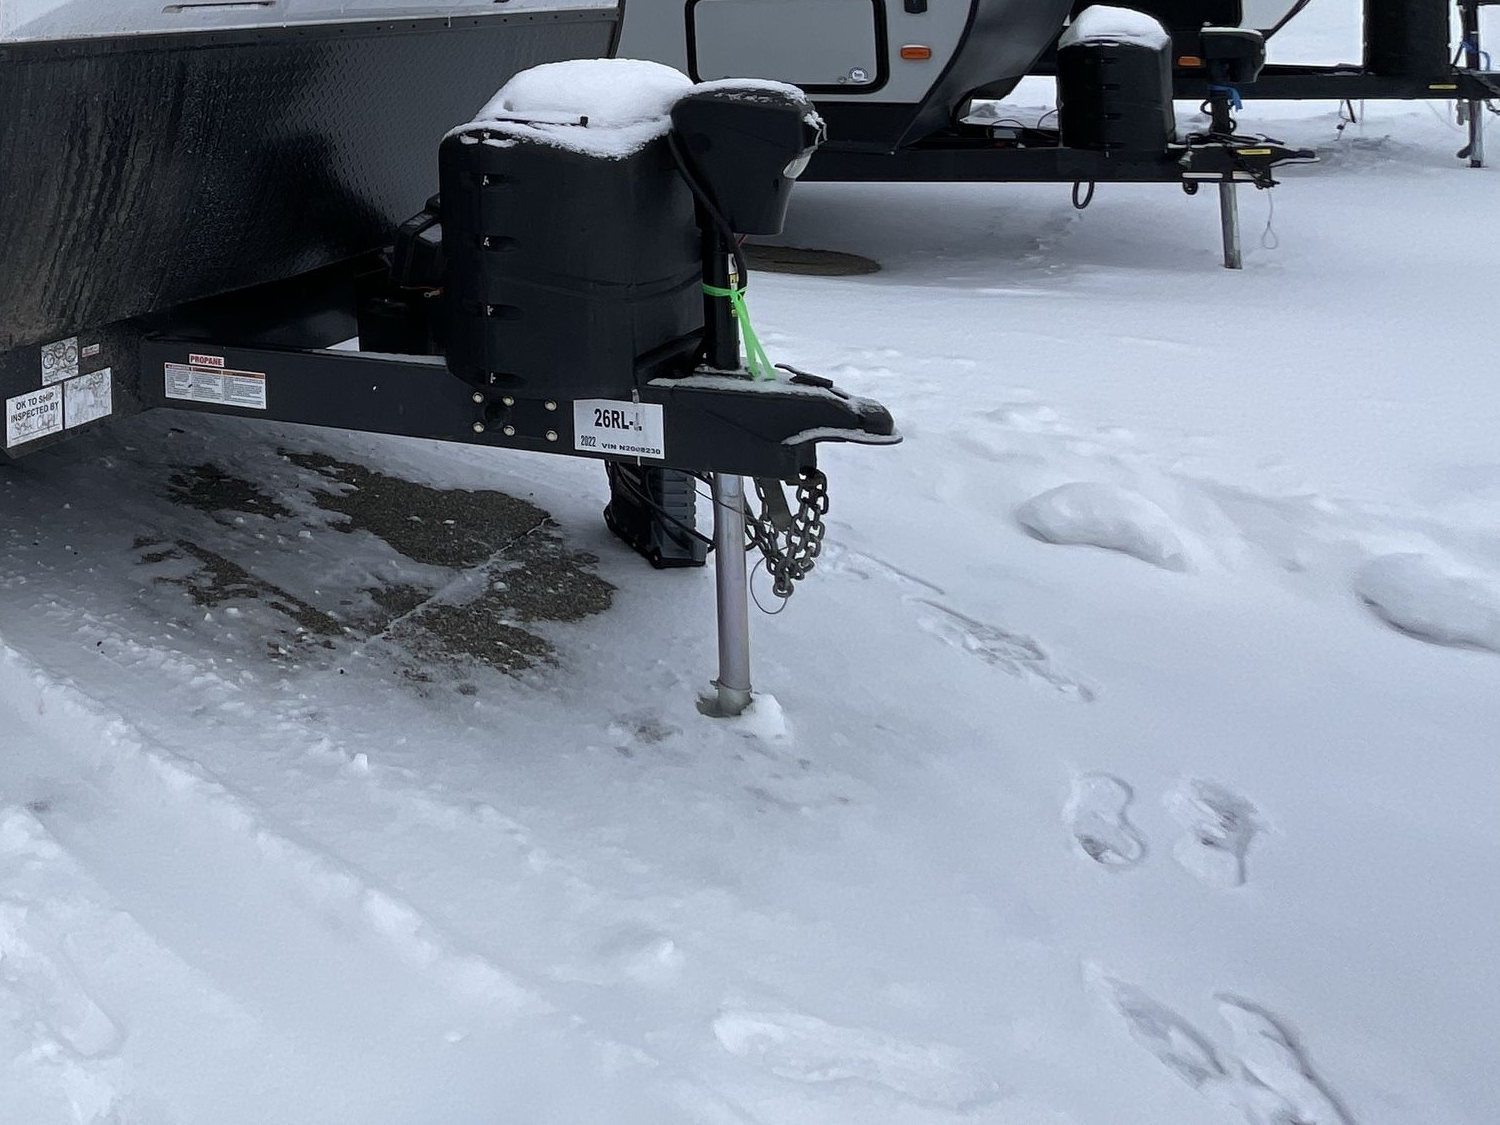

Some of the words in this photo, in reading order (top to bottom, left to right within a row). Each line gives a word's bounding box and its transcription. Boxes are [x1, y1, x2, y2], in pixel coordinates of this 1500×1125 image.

[190, 356, 223, 366] PROPANE
[16, 401, 27, 410] OK
[28, 397, 38, 406] TO
[39, 392, 54, 404] SHIP
[11, 405, 49, 423] INSPECTED
[50, 401, 59, 411] BY
[581, 435, 597, 447] 2022
[601, 443, 617, 451] VIN
